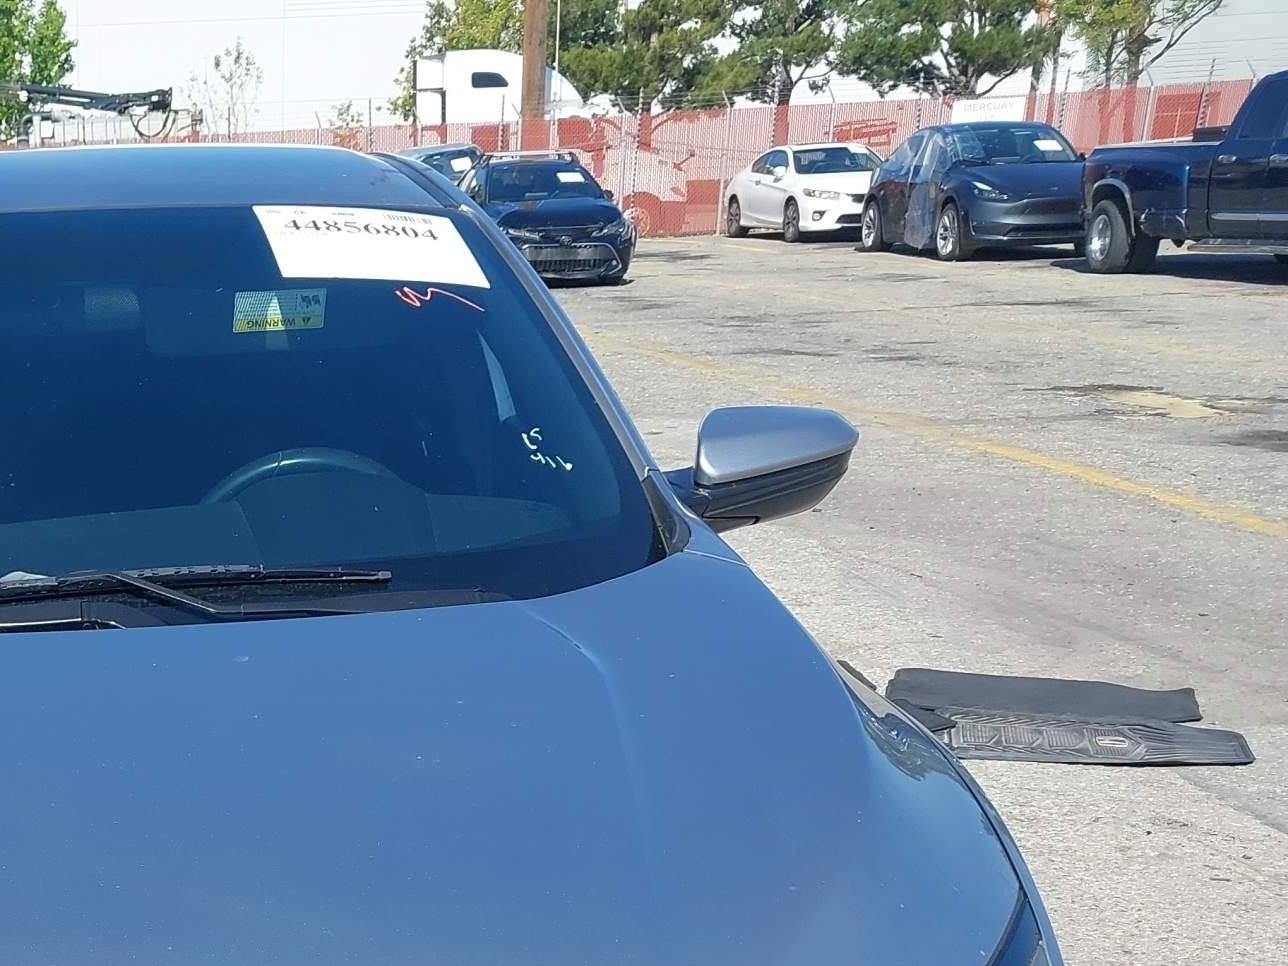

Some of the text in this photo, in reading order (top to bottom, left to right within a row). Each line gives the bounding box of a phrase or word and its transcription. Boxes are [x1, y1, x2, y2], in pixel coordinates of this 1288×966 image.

[963, 101, 1015, 112] MERCURY
[284, 218, 438, 241] 44856804
[245, 317, 297, 330] WARNING
